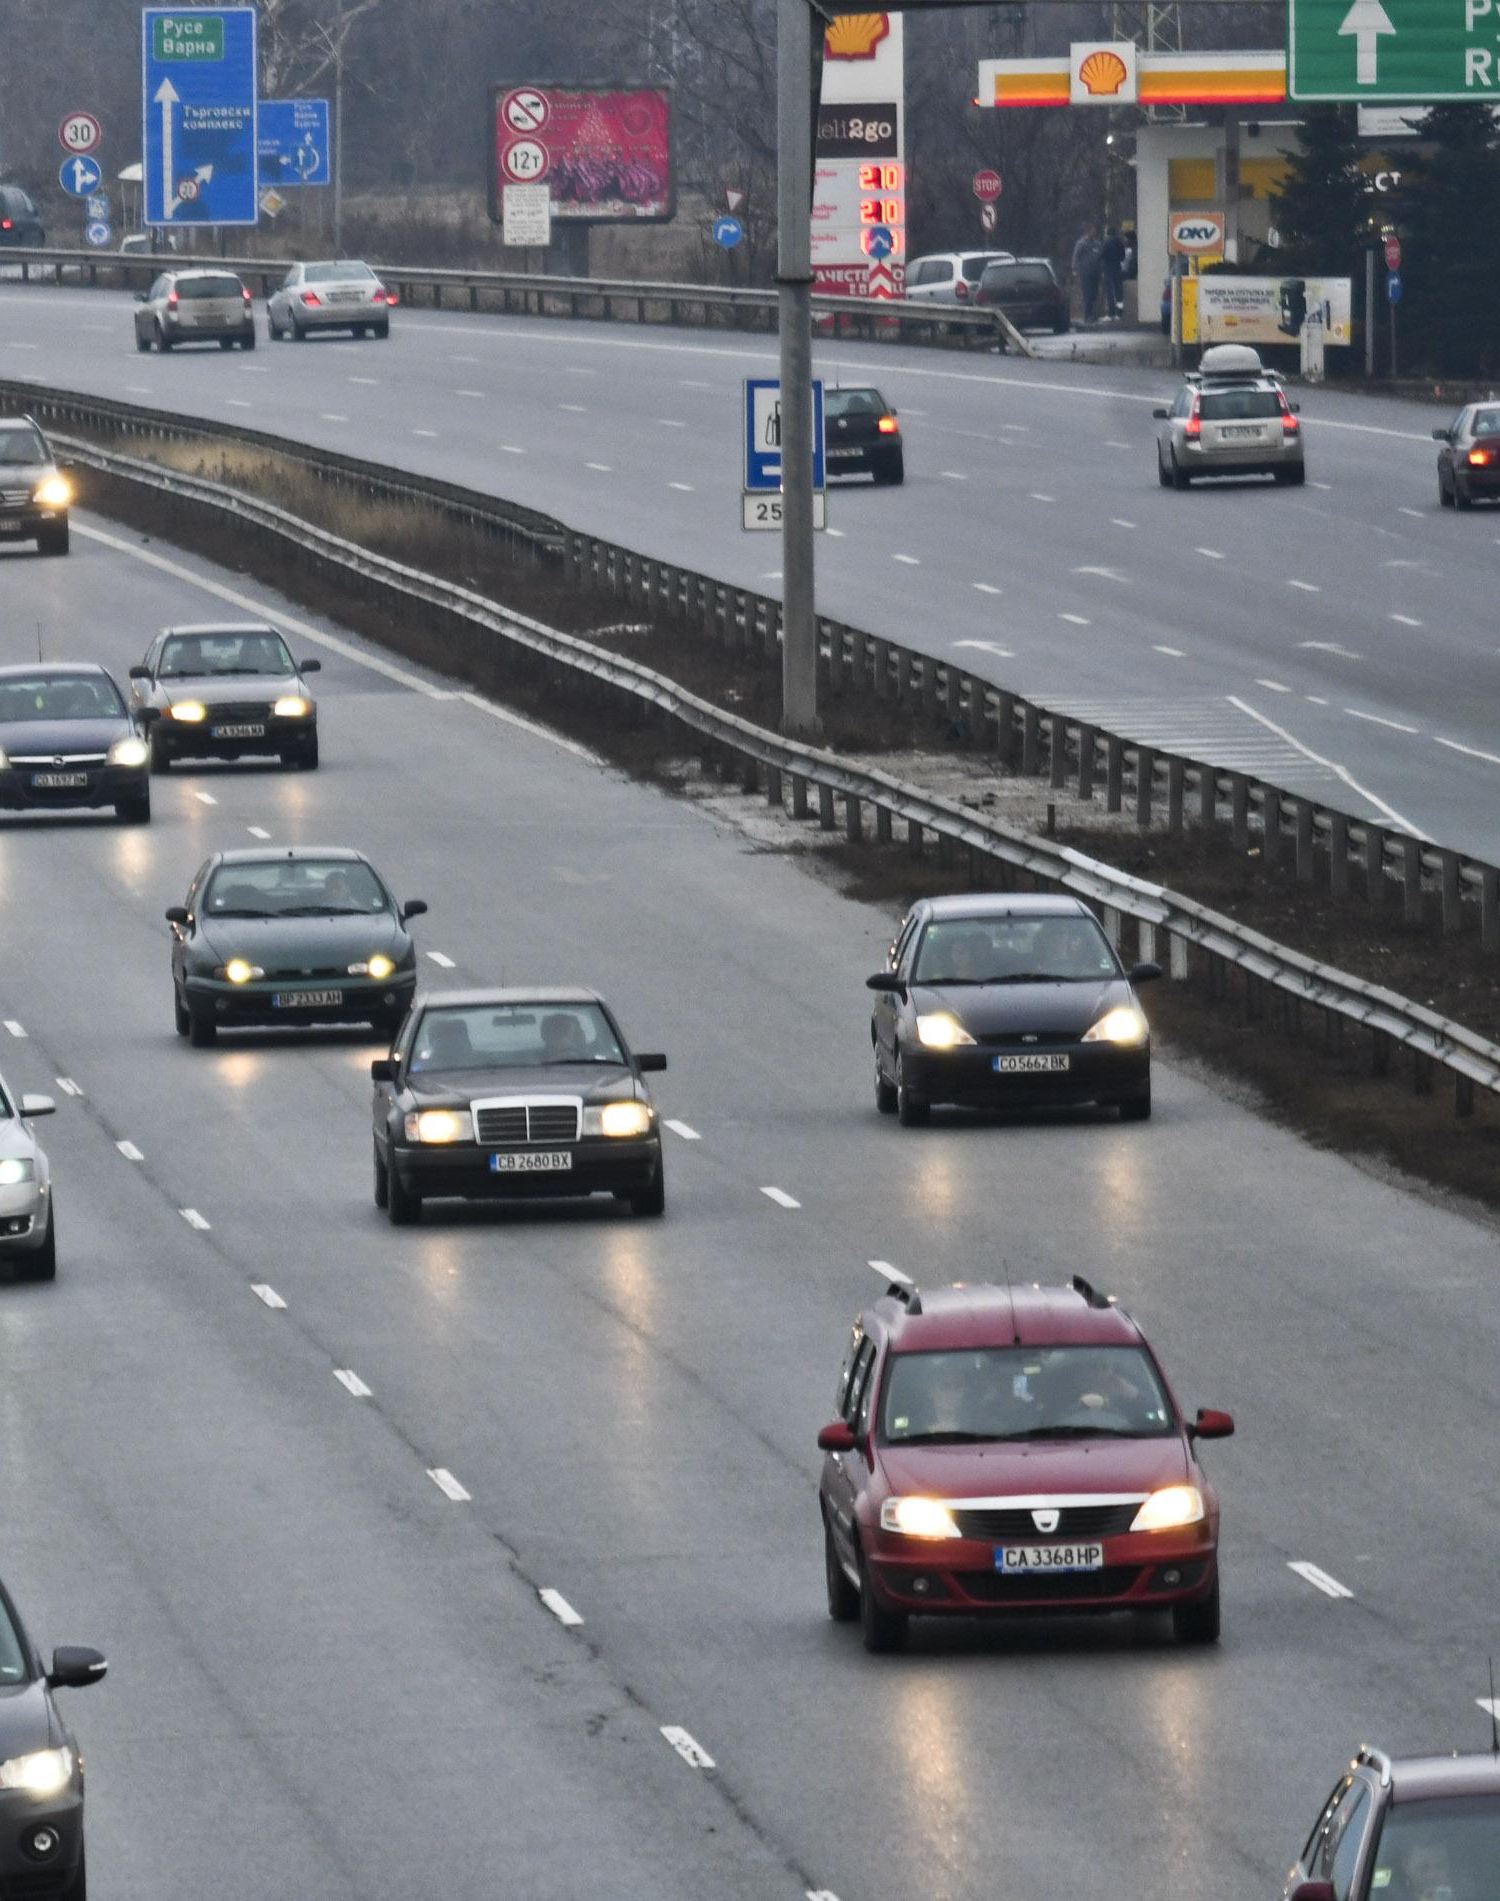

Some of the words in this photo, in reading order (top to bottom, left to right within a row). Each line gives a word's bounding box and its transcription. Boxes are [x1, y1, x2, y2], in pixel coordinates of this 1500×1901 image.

[163, 19, 203, 37] Русе
[163, 39, 215, 57] Варна
[1466, 48, 1500, 86] R
[182, 105, 250, 120] Търговски
[69, 124, 91, 143] 30
[183, 120, 244, 131] комплекс
[818, 118, 892, 143] eli2go
[975, 179, 999, 192] STOP
[1177, 226, 1217, 240] DKV
[756, 503, 783, 521] 25
[498, 1155, 516, 1169] CB
[518, 1155, 549, 1169] 2680
[552, 1153, 568, 1168] BX
[1005, 1549, 1028, 1567] CA
[1032, 1548, 1074, 1567] 3368
[1077, 1546, 1100, 1565] HP
